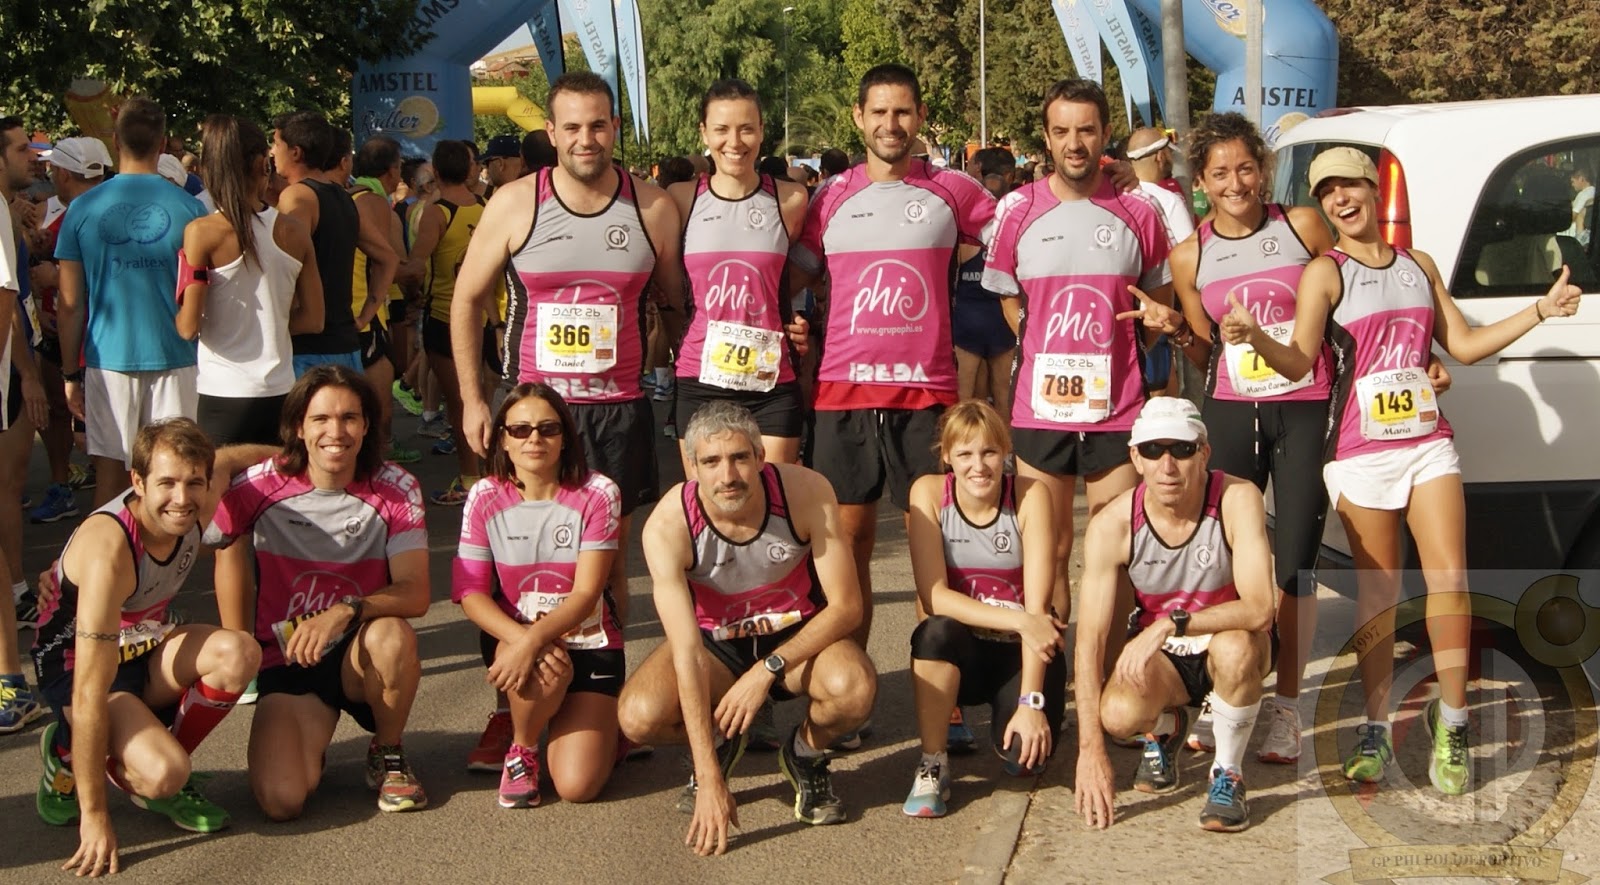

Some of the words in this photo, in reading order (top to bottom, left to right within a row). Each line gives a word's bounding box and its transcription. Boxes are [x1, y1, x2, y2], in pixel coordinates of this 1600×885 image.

[359, 72, 438, 93] AMSTEL
[1231, 86, 1318, 108] ASTEL
[360, 109, 421, 136] Radler
[550, 324, 590, 346] 366
[856, 324, 923, 336] www.grupophi.es
[554, 359, 585, 367] Daniel
[724, 342, 750, 366] 79
[1044, 374, 1083, 397] 788
[1374, 388, 1413, 415] 143
